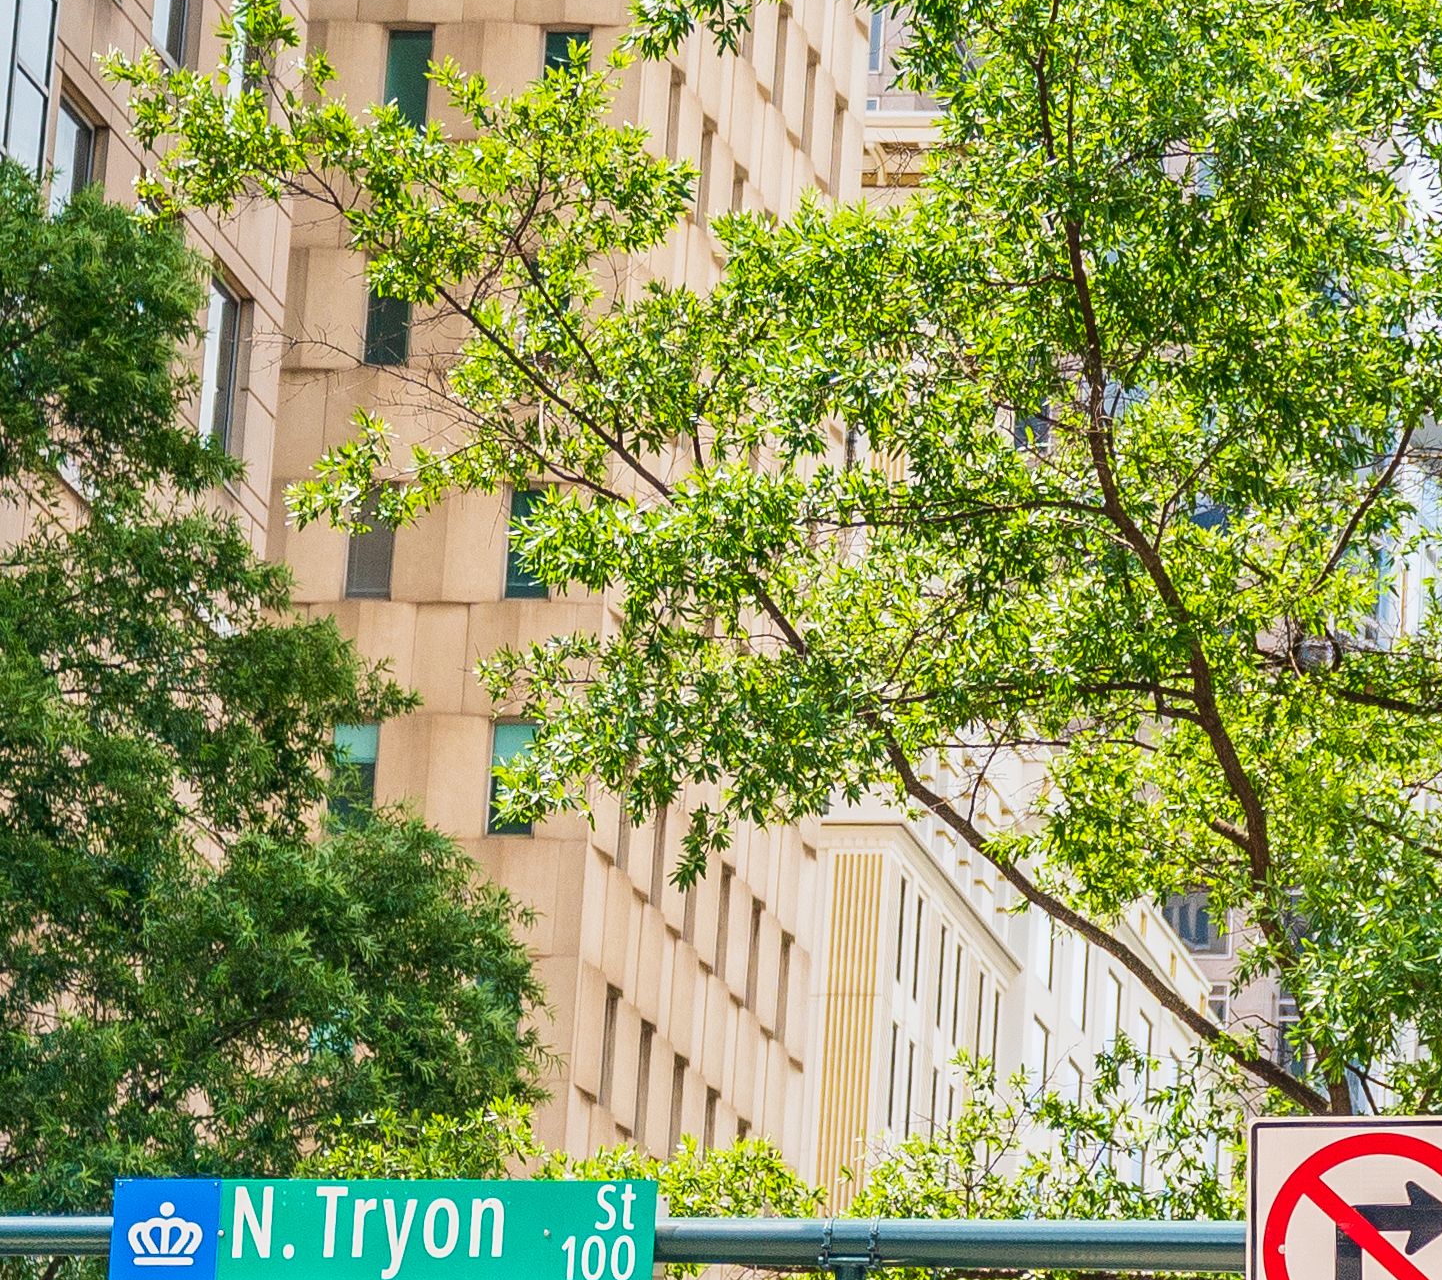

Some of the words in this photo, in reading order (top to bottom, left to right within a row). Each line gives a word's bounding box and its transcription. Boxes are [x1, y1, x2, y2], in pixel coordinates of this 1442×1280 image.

[231, 1185, 295, 1260] N.
[317, 1187, 505, 1279] Tryon
[595, 1183, 637, 1230] St
